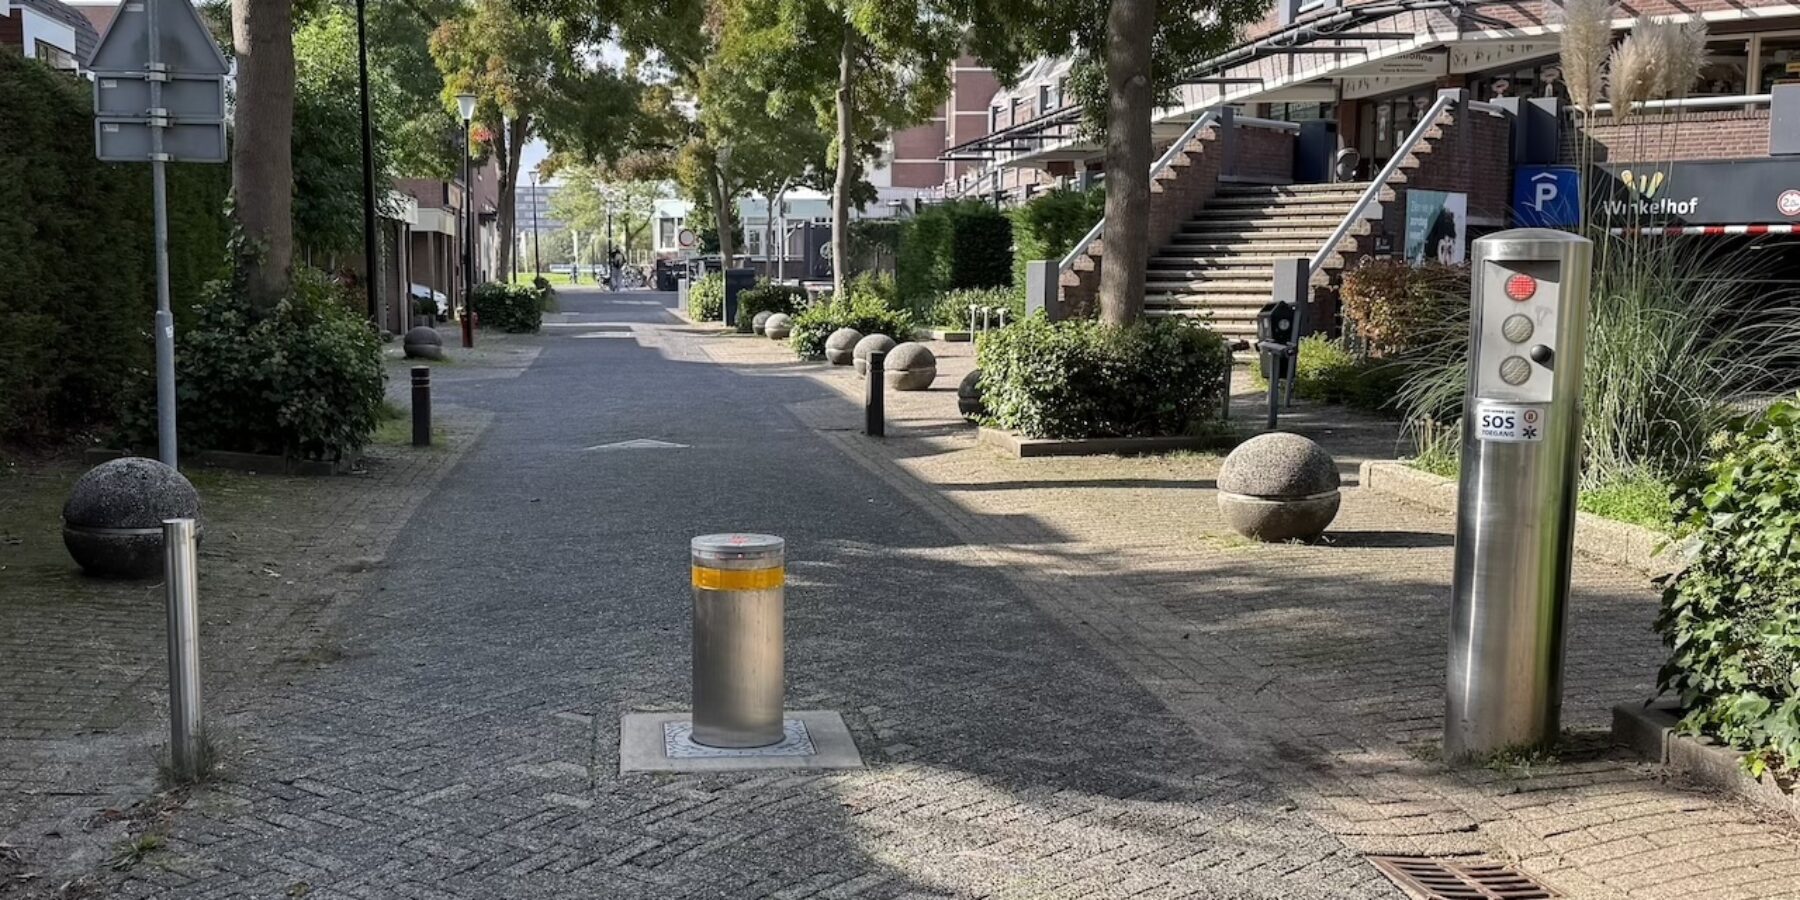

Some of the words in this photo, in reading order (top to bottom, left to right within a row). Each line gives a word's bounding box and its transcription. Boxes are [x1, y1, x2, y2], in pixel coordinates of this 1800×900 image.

[1535, 183, 1557, 211] P
[1603, 197, 1698, 215] Winkelhof
[1482, 415, 1515, 429] SOS
